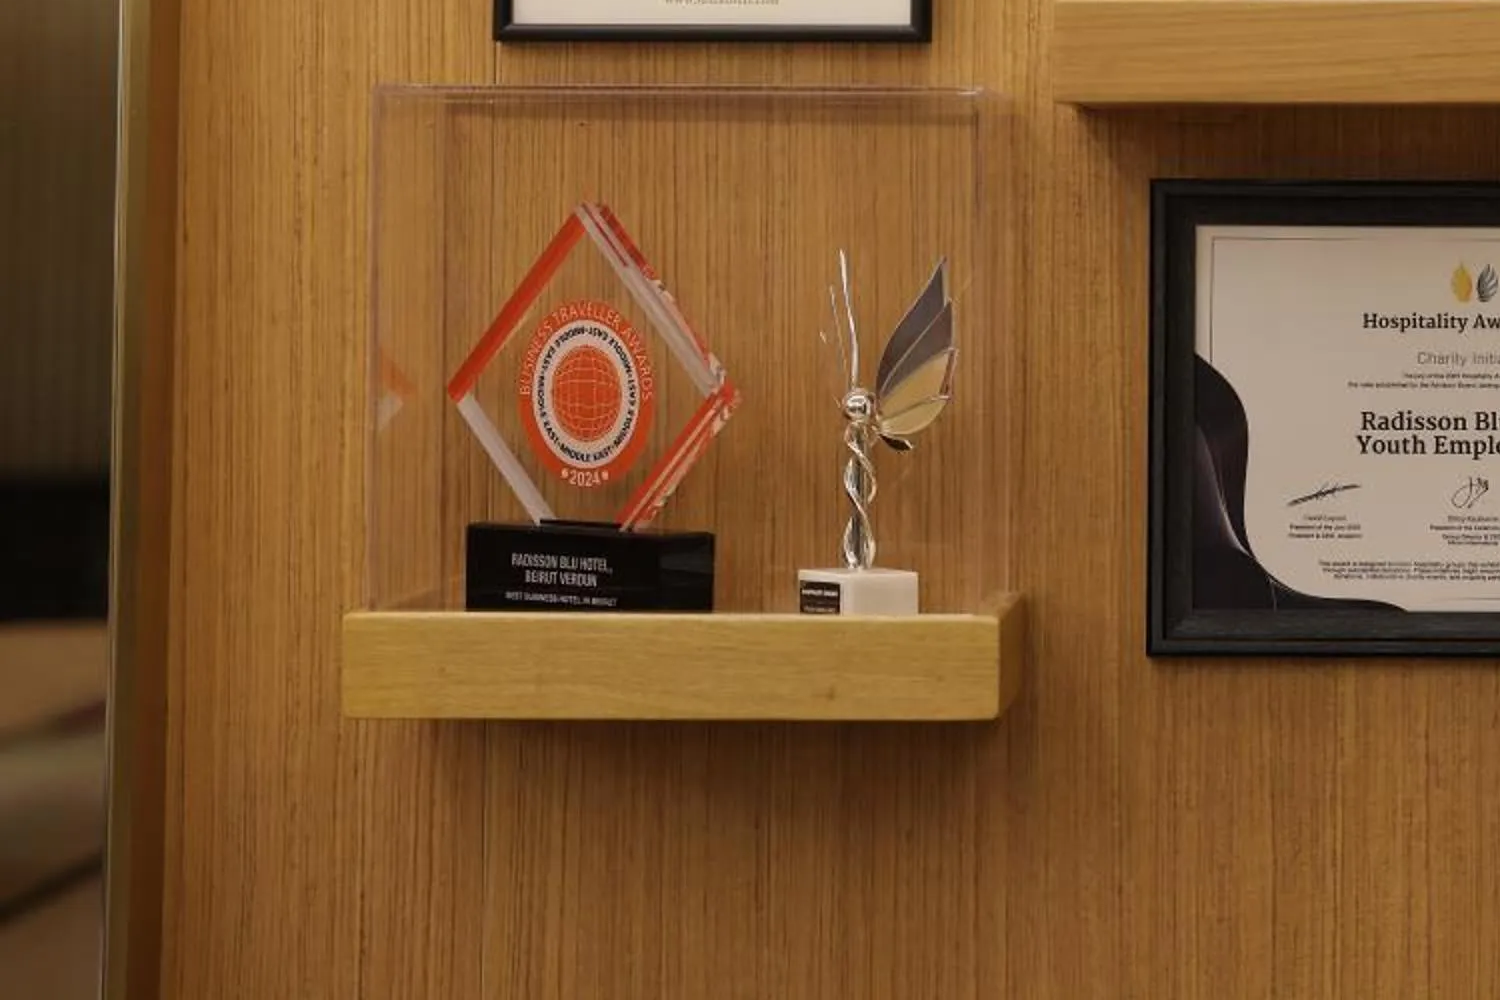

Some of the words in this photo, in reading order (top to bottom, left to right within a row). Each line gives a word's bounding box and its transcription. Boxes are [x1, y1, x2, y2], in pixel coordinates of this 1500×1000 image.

[1362, 312, 1468, 333] Hospitality
[553, 303, 621, 328] TRAVELLER
[622, 327, 653, 401] AWARDS
[1417, 351, 1467, 368] Charity
[1360, 410, 1467, 431] Radisson
[1357, 435, 1427, 455] Youth
[570, 471, 600, 487] 2024
[512, 552, 557, 568] RADISSON
[559, 554, 578, 569] BLU
[525, 571, 557, 585] BEIRUT
[560, 572, 598, 588] VERDUN
